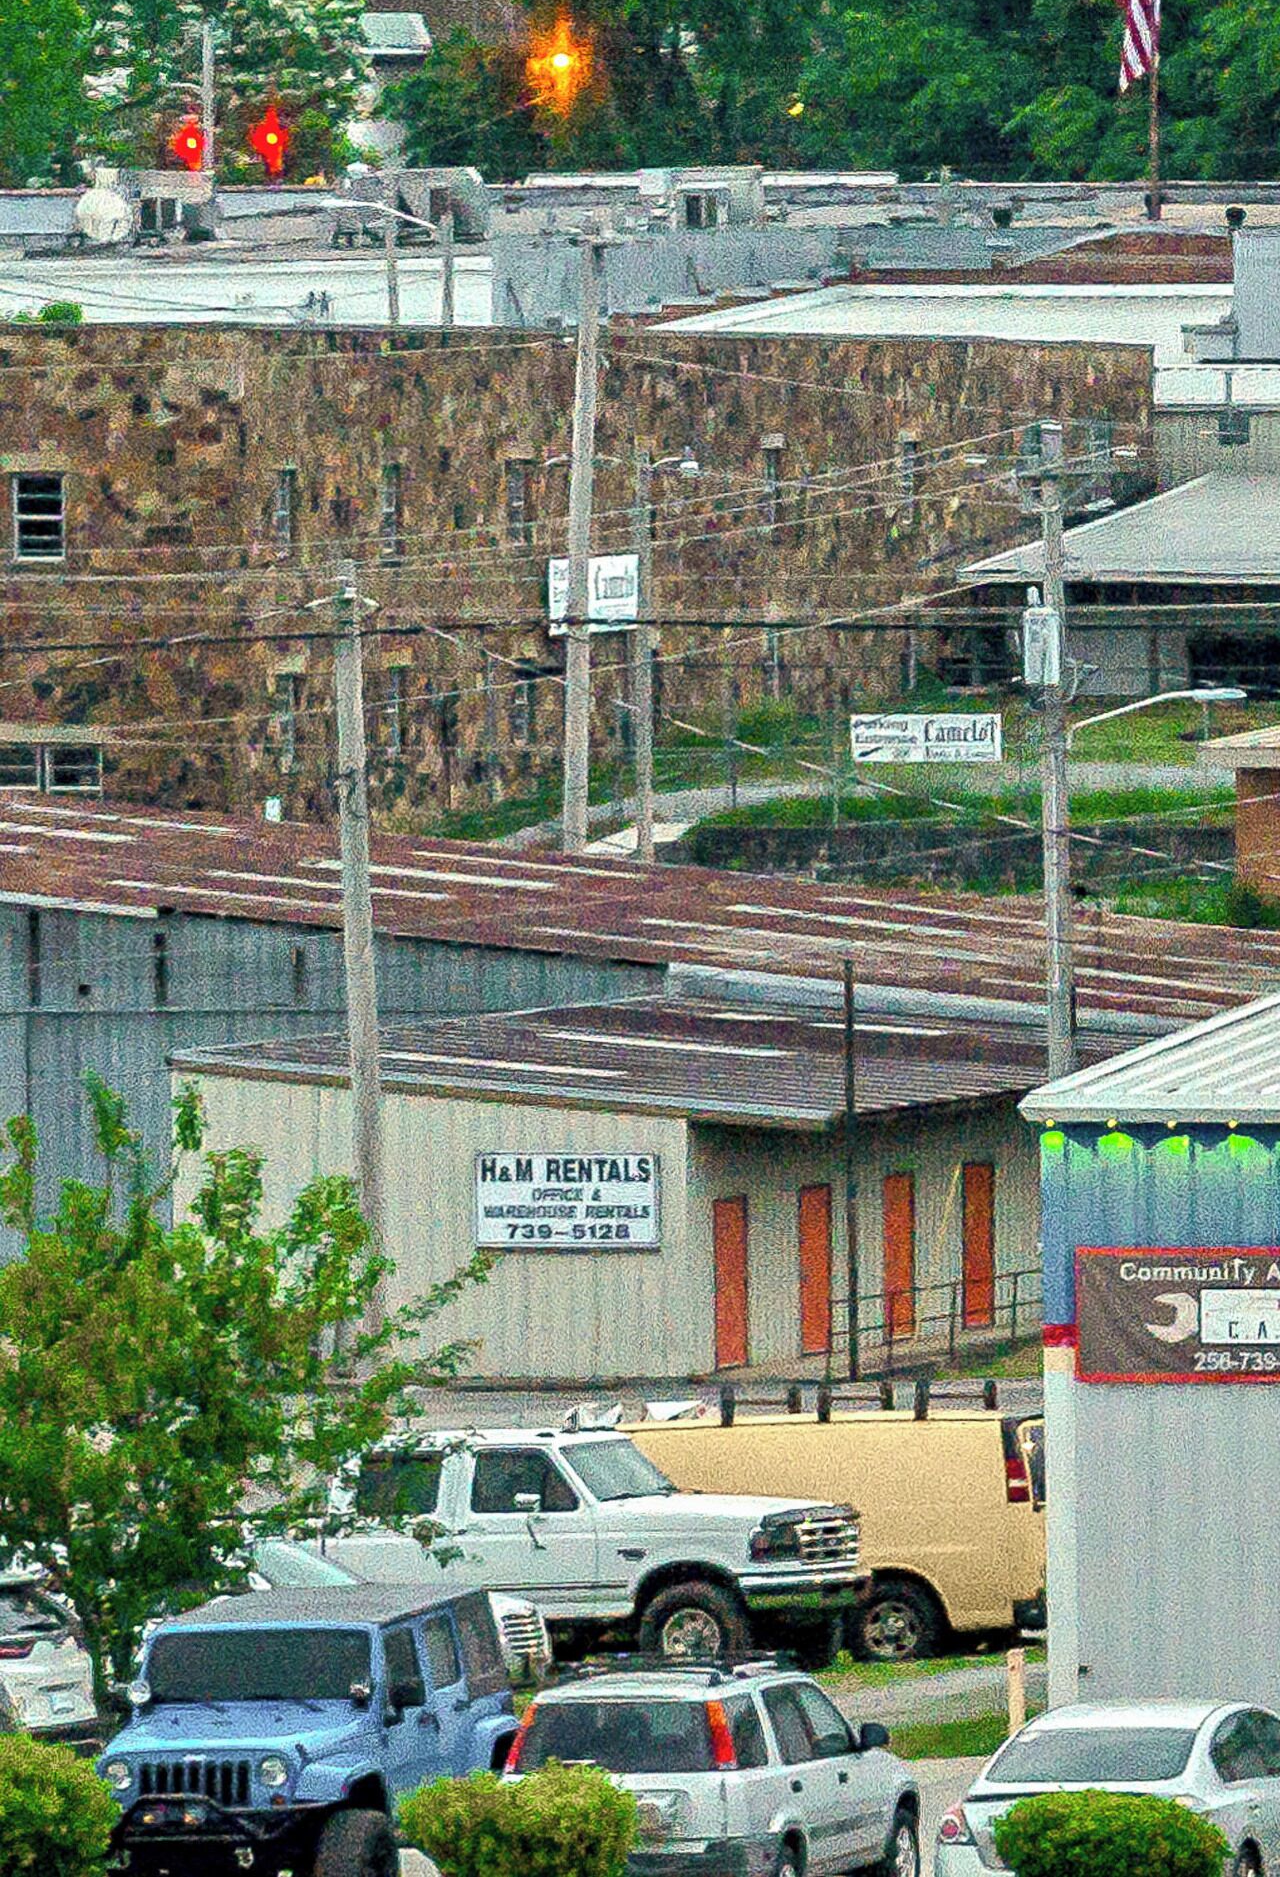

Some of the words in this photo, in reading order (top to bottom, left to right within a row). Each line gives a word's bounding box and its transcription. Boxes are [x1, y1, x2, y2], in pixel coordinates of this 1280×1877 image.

[481, 1158, 533, 1182] H&M
[546, 1157, 651, 1183] RENTALS
[532, 1187, 583, 1202] OFFICE
[484, 1204, 577, 1218] WAREHOUSE
[585, 1204, 651, 1218] RENTALS
[1120, 1259, 1256, 1286] Community
